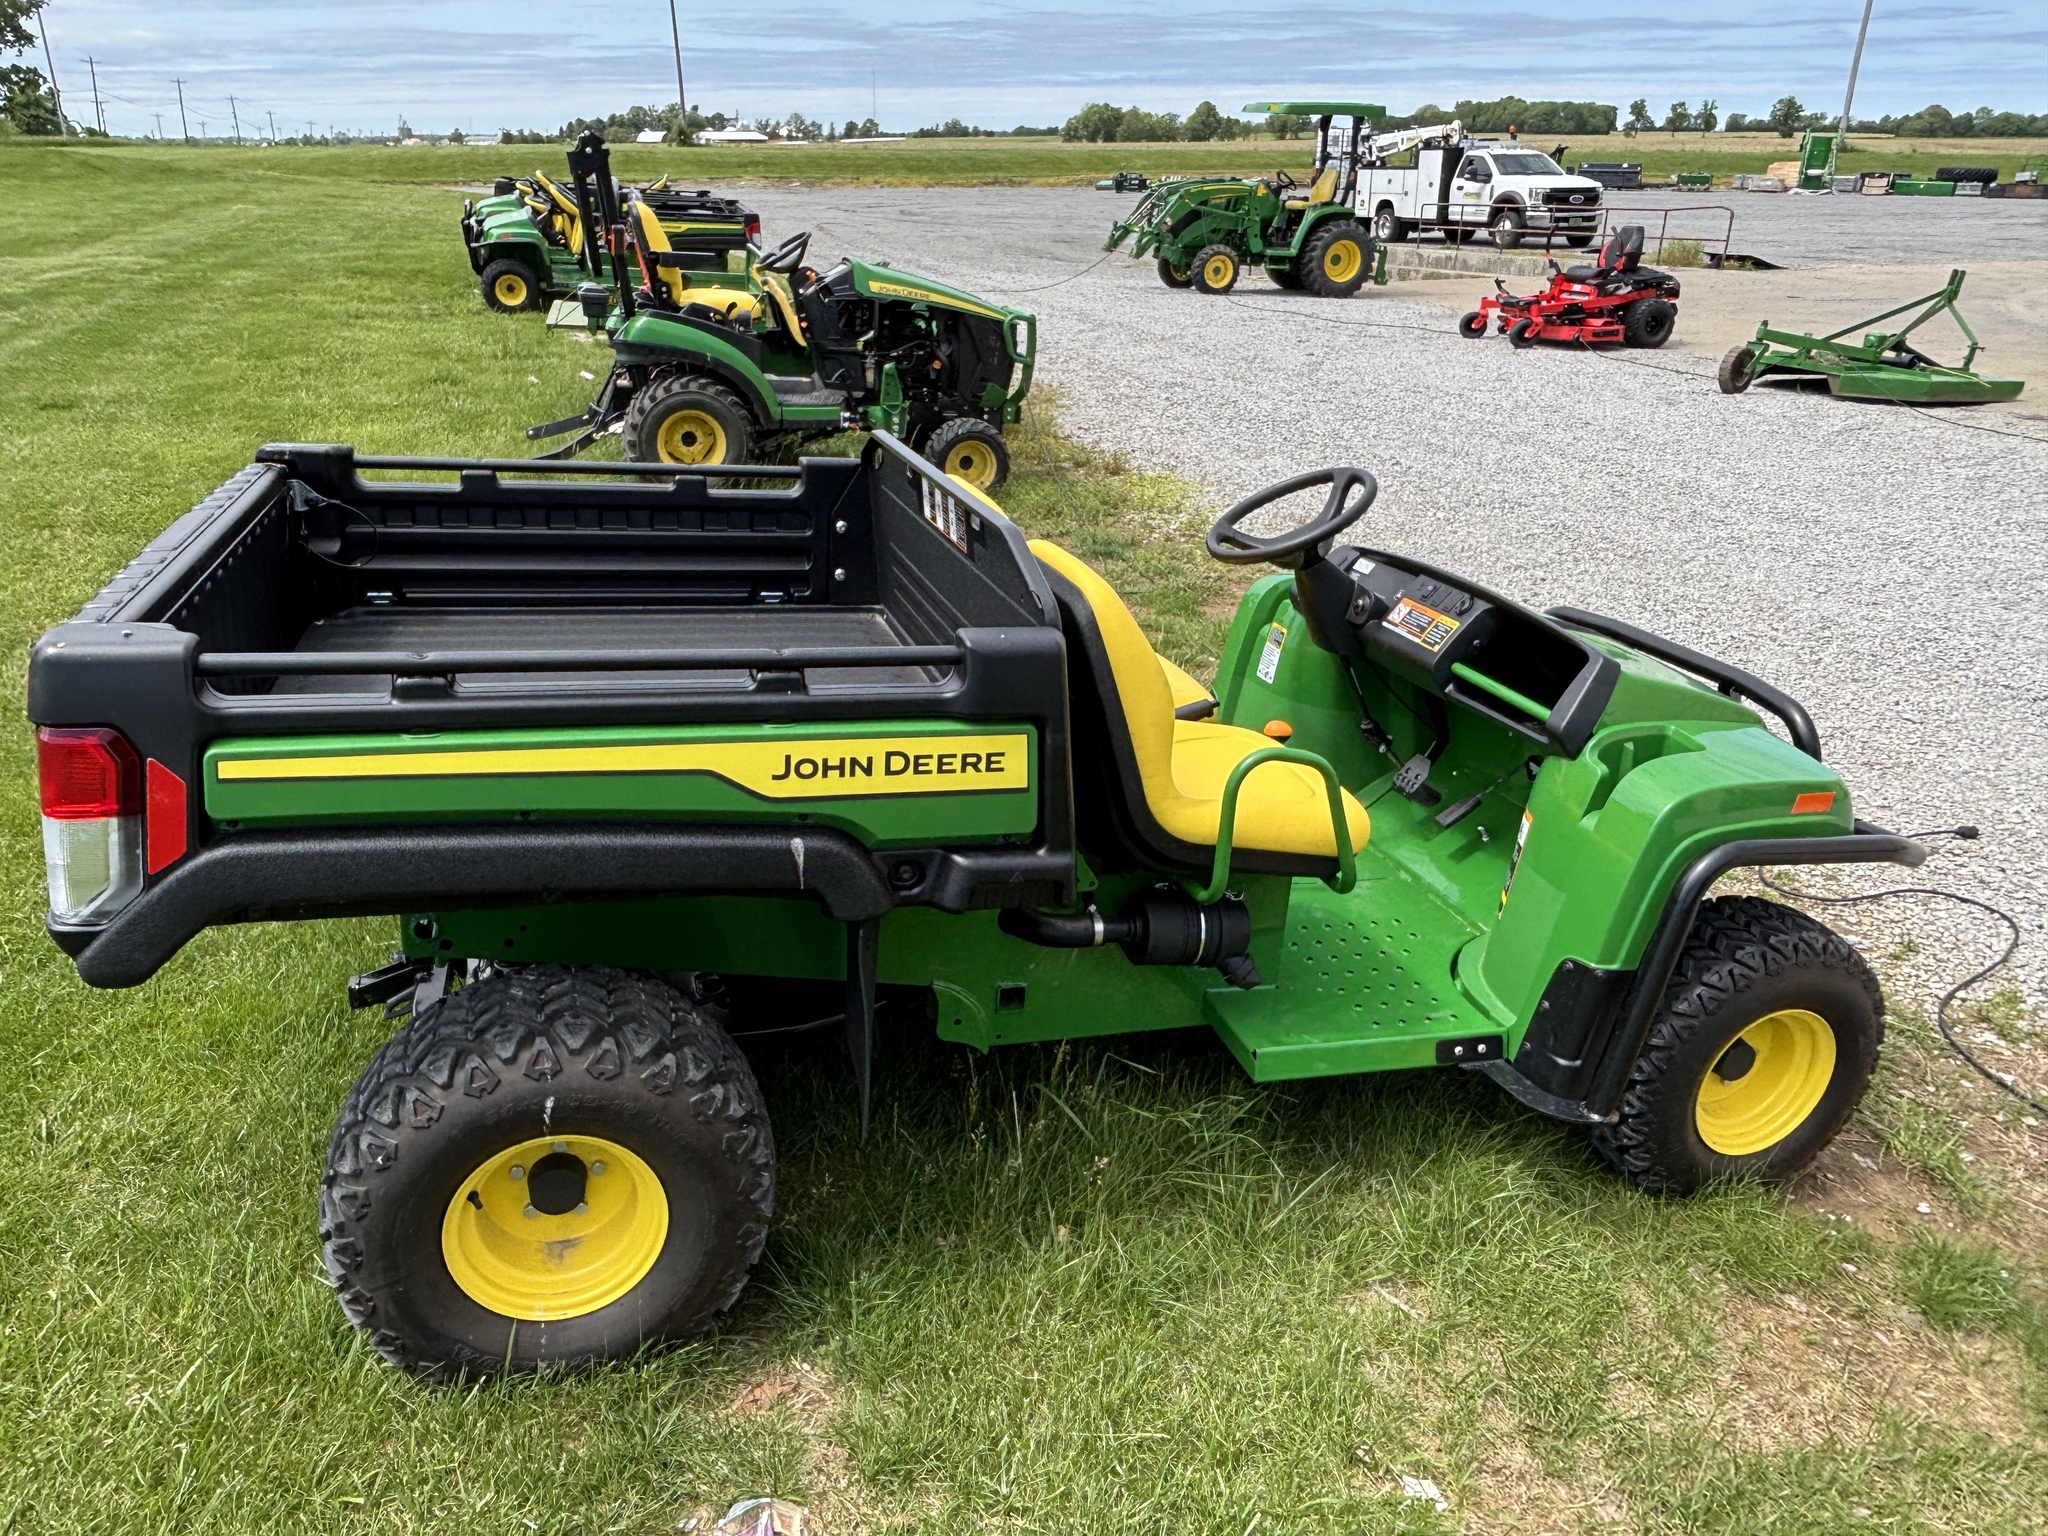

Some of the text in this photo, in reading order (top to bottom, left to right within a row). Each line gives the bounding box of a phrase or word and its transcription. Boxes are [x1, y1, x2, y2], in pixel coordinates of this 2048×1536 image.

[878, 286, 931, 300] JOHN DEERE
[771, 750, 1006, 781] JOHN DEERE
